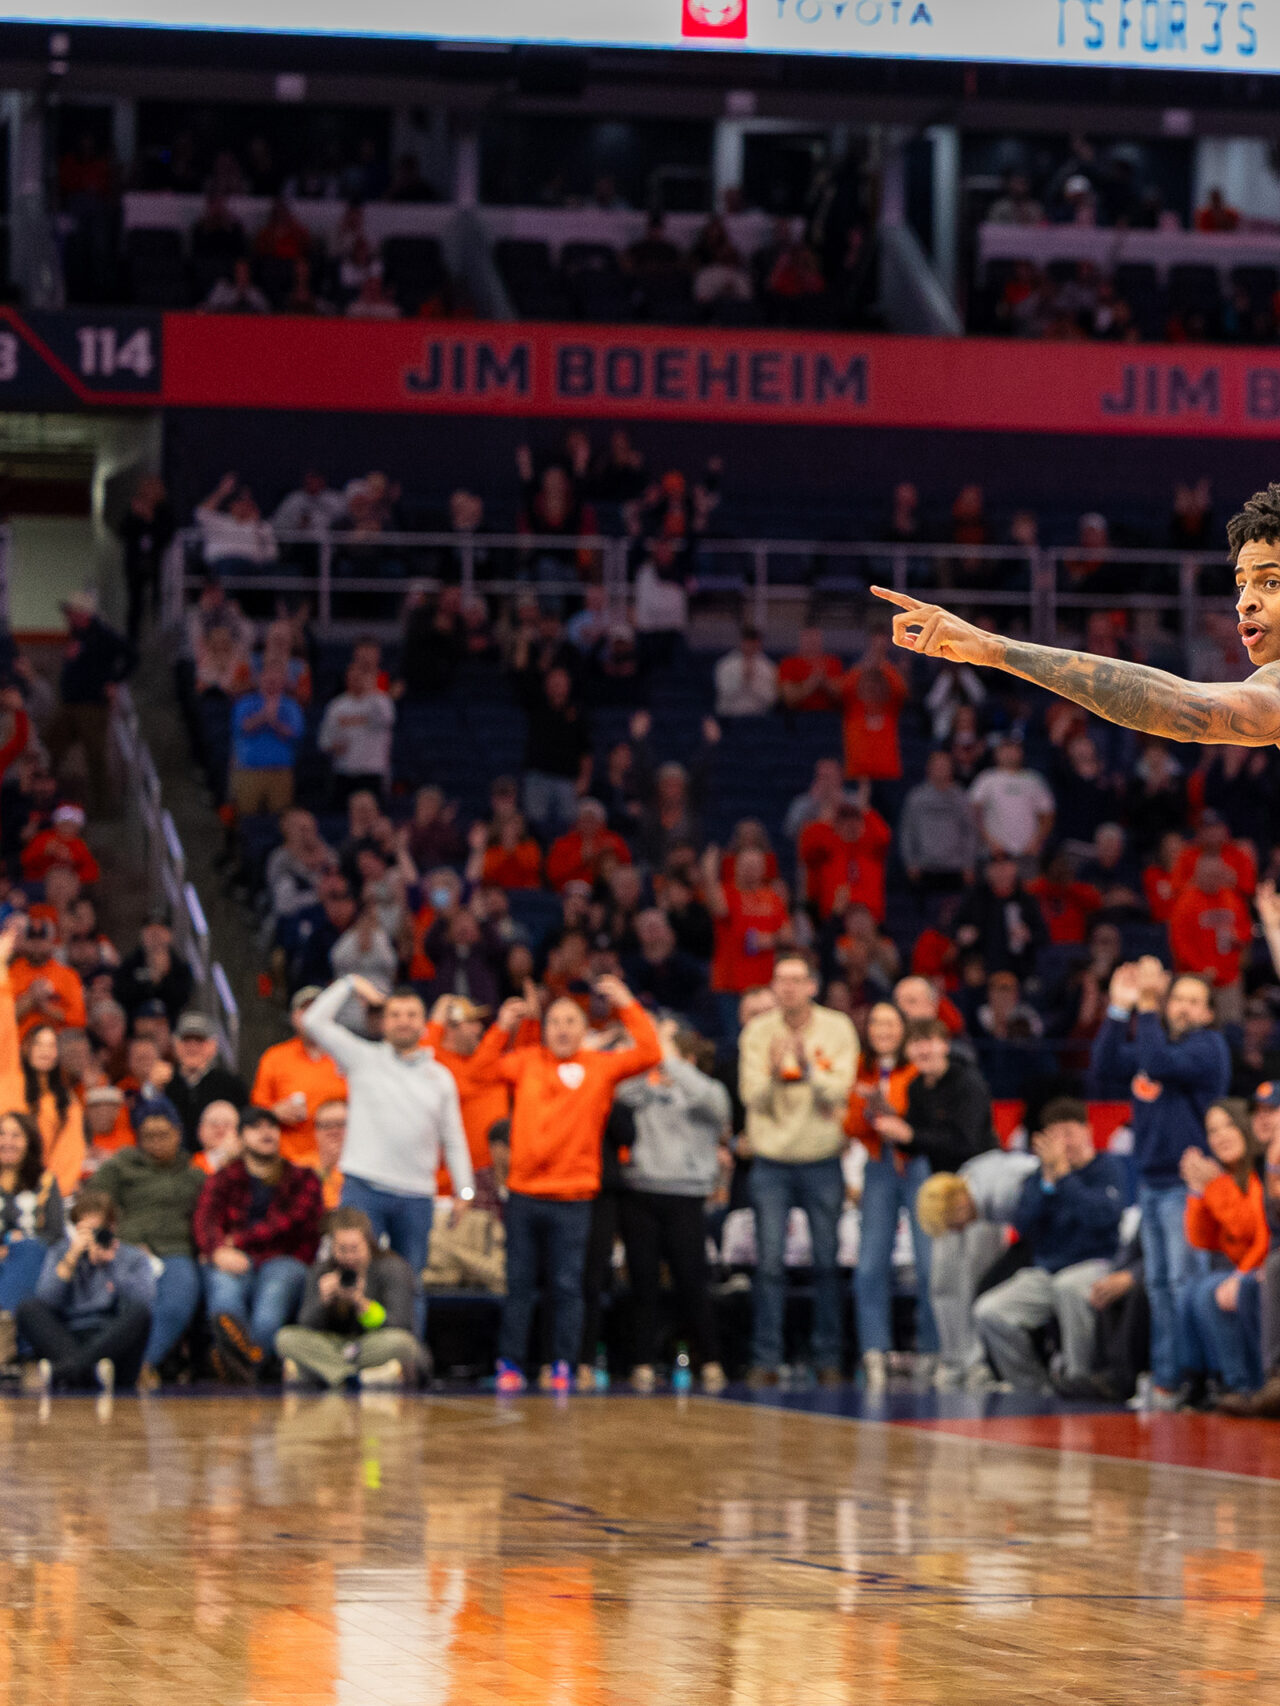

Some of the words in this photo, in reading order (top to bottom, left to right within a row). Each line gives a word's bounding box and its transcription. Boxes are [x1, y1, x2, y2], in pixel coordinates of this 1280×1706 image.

[776, 0, 933, 26] TOYOTA
[1117, 0, 1188, 53] FOR
[77, 326, 153, 378] 114
[404, 340, 532, 395] JIM
[554, 344, 870, 407] BOEHEIM
[1100, 363, 1222, 417] JIM
